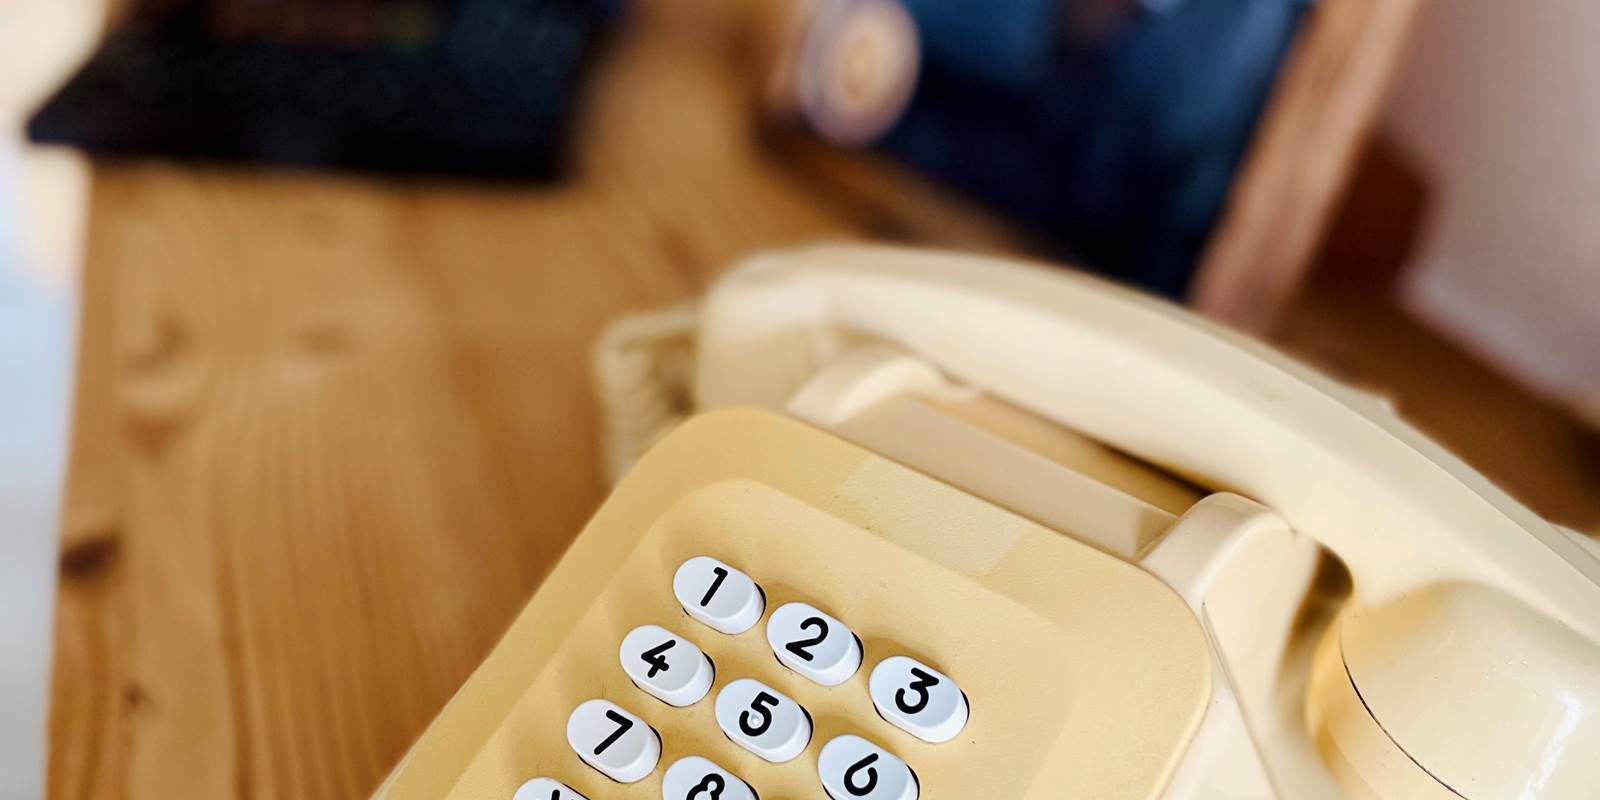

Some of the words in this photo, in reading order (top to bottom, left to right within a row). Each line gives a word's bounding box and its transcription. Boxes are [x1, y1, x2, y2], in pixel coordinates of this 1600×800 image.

[700, 566, 728, 607] 1
[640, 639, 676, 679] 4
[785, 616, 829, 662] 2
[738, 691, 780, 737] 5
[894, 667, 940, 715] 3
[593, 709, 634, 756] 7
[843, 753, 879, 797] 6
